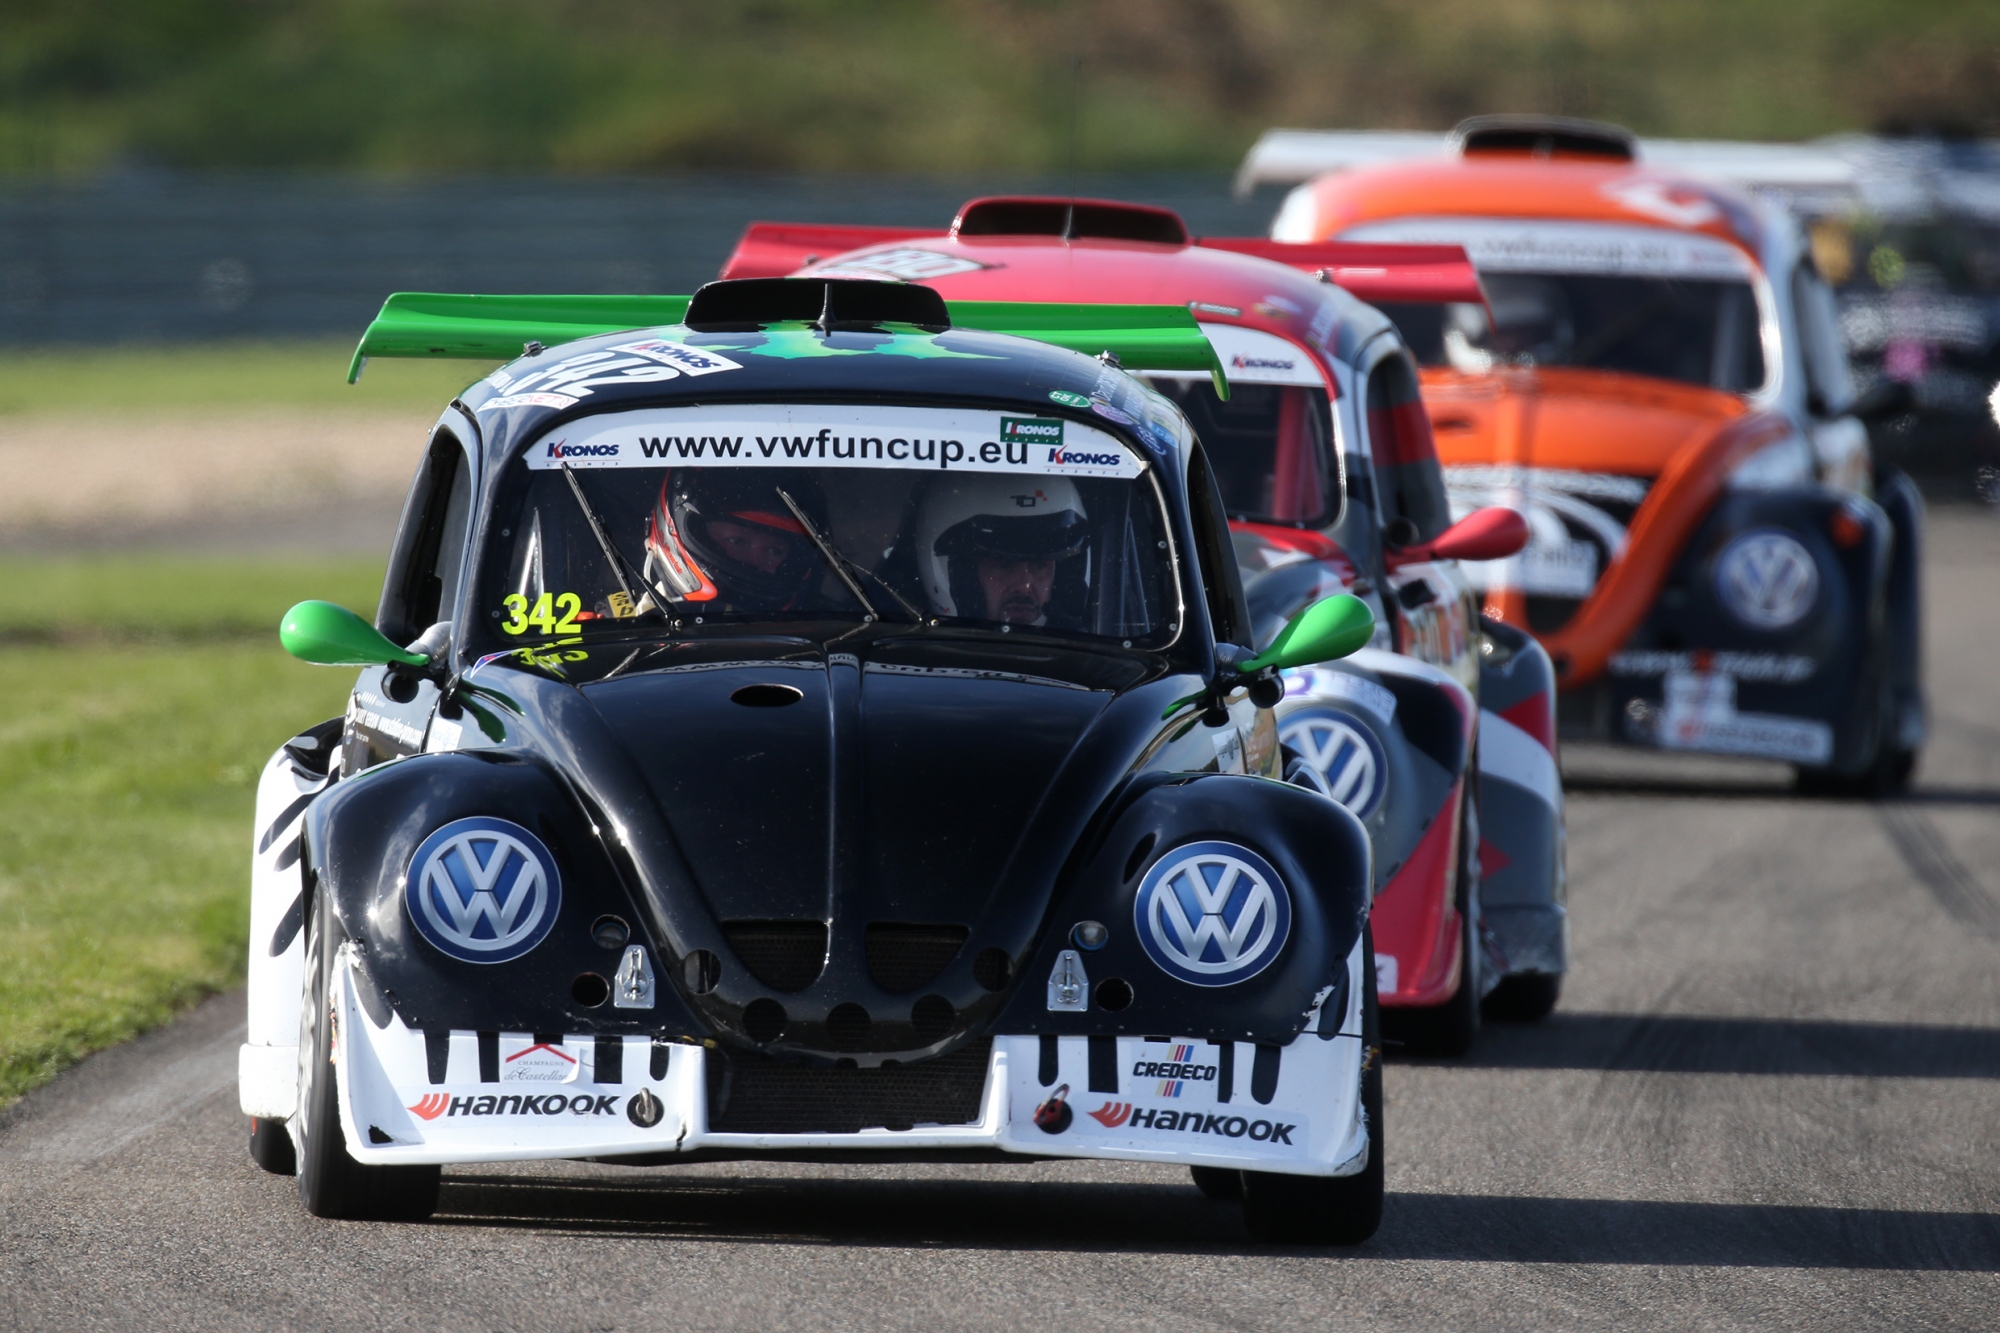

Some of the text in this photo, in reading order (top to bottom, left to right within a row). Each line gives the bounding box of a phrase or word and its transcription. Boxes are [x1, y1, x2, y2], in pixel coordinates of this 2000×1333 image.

[1005, 420, 1060, 436] KRONOS
[547, 438, 620, 458] KRONOS
[638, 428, 1029, 469] www.vwfuncup.eu
[1047, 444, 1121, 465] KRONOS
[502, 592, 582, 635] 342
[1132, 1061, 1217, 1082] CREDECO
